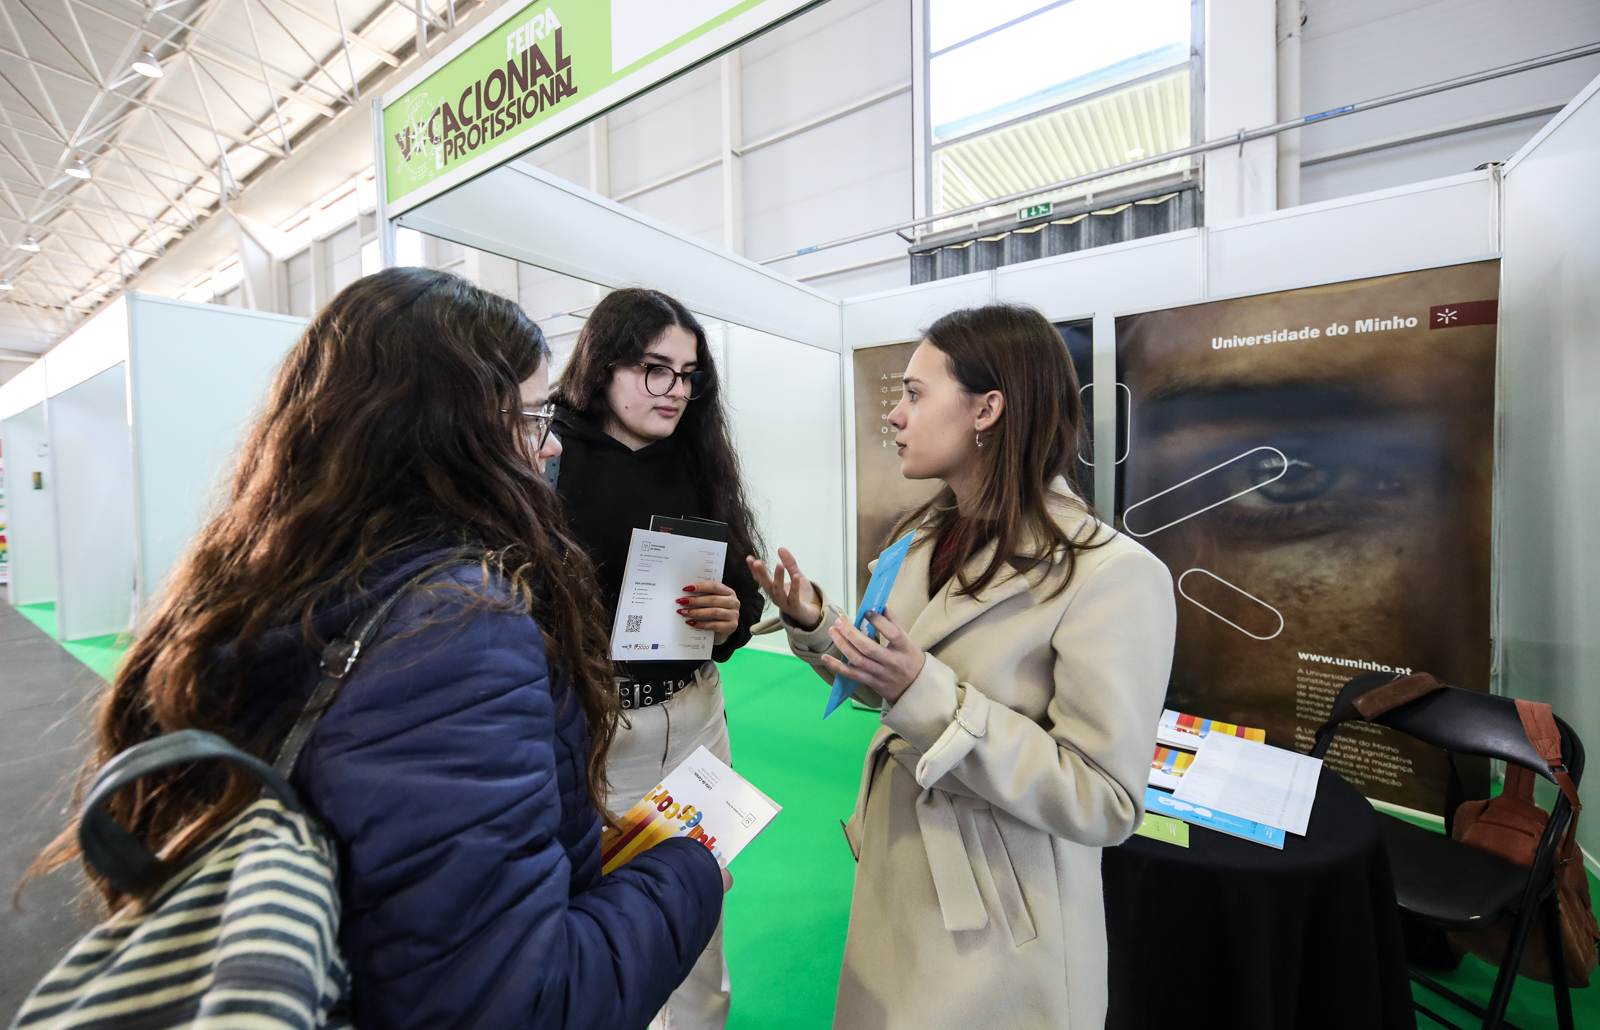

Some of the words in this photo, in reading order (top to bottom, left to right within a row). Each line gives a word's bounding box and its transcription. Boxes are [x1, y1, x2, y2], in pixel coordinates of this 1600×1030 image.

[507, 7, 562, 62] FEIRA
[444, 66, 578, 166] PROFISSIONAL
[1211, 327, 1320, 350] Universidade
[1325, 323, 1349, 337] do
[1355, 315, 1418, 334] Minho
[1297, 651, 1413, 676] www.uminho.pt
[1308, 685, 1335, 695] ensino
[1340, 745, 1359, 753] uma
[1361, 749, 1413, 765] significativa
[1358, 740, 1371, 748] do
[1372, 742, 1399, 754] Minho
[1343, 753, 1362, 762] para
[1371, 766, 1398, 778] várias
